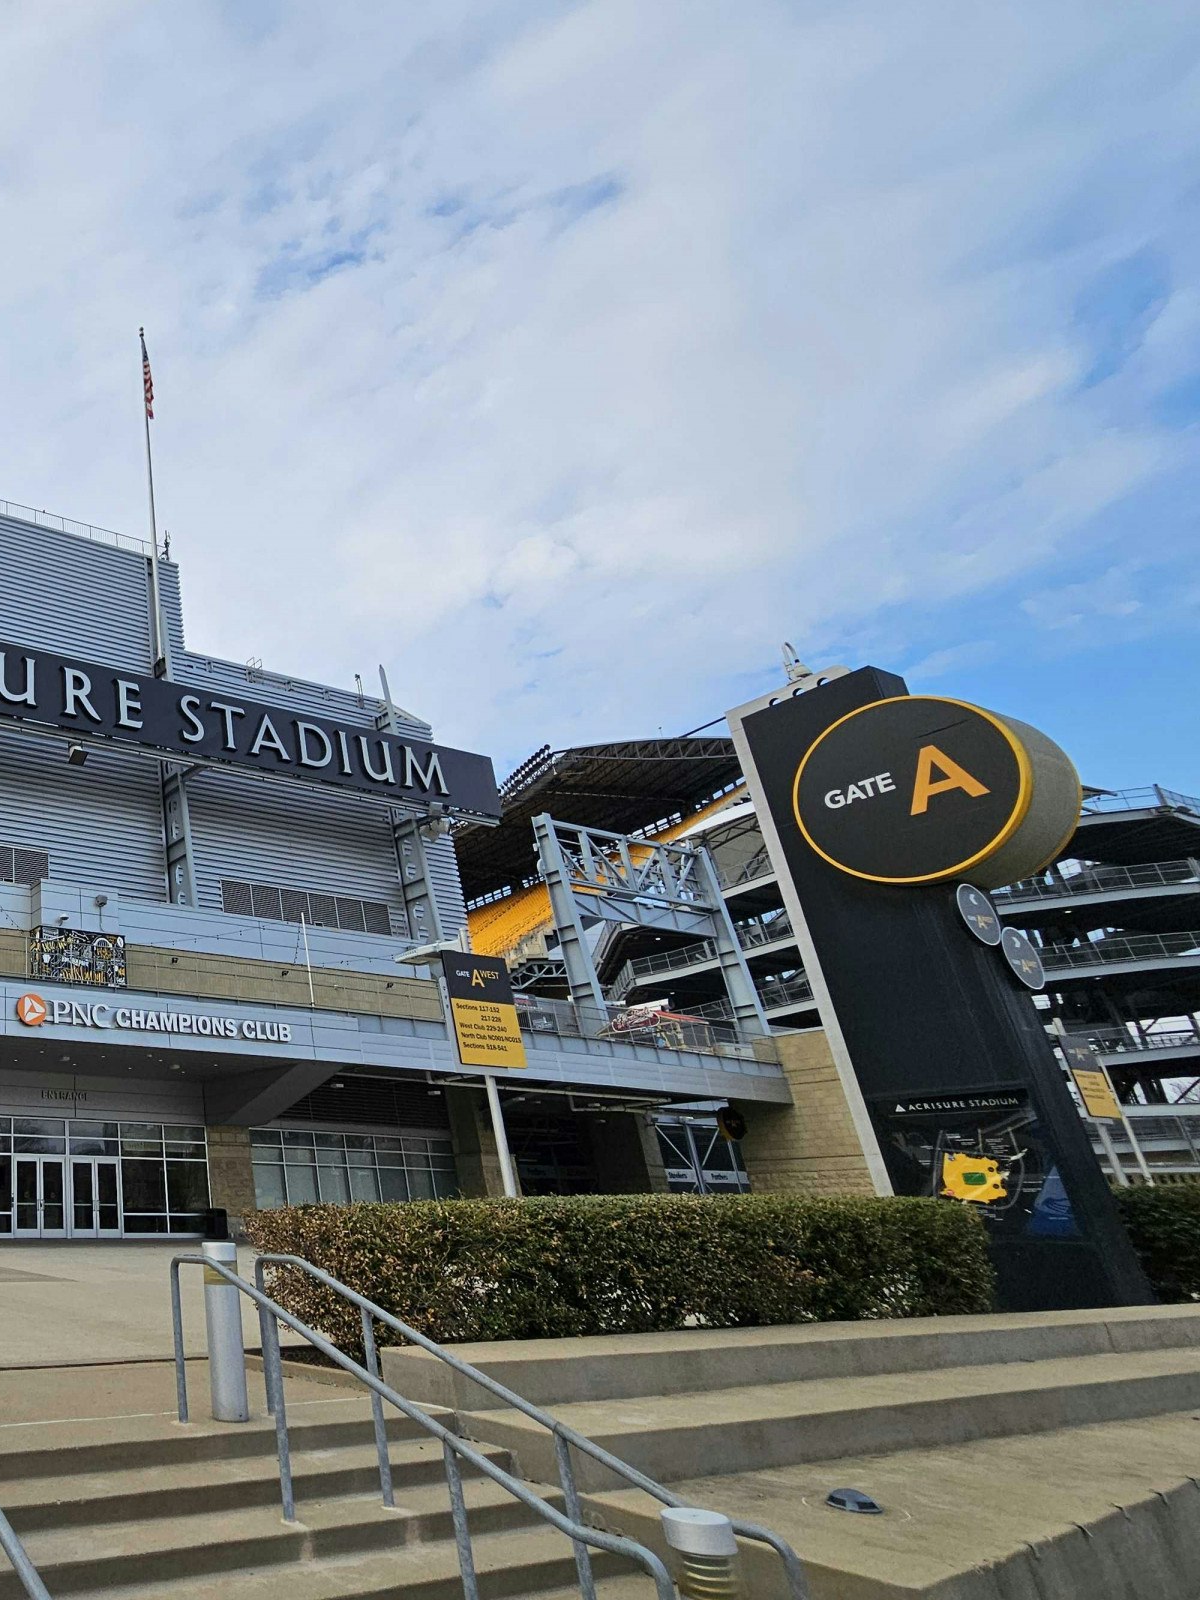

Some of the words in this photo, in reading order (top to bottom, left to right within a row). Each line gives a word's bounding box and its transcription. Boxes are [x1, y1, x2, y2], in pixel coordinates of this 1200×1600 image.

[179, 694, 452, 797] STADIUM
[824, 772, 896, 809] GATE
[910, 745, 991, 816] A
[455, 970, 470, 978] GATE
[471, 969, 485, 988] A
[479, 970, 499, 980] WEST
[51, 1000, 110, 1028] PNC
[116, 1008, 238, 1037] CHAMPIONS
[242, 1021, 292, 1042] CLUB
[456, 1002, 478, 1011] Sections
[908, 1101, 966, 1111] ACRISURE
[969, 1098, 1019, 1107] STADIUM
